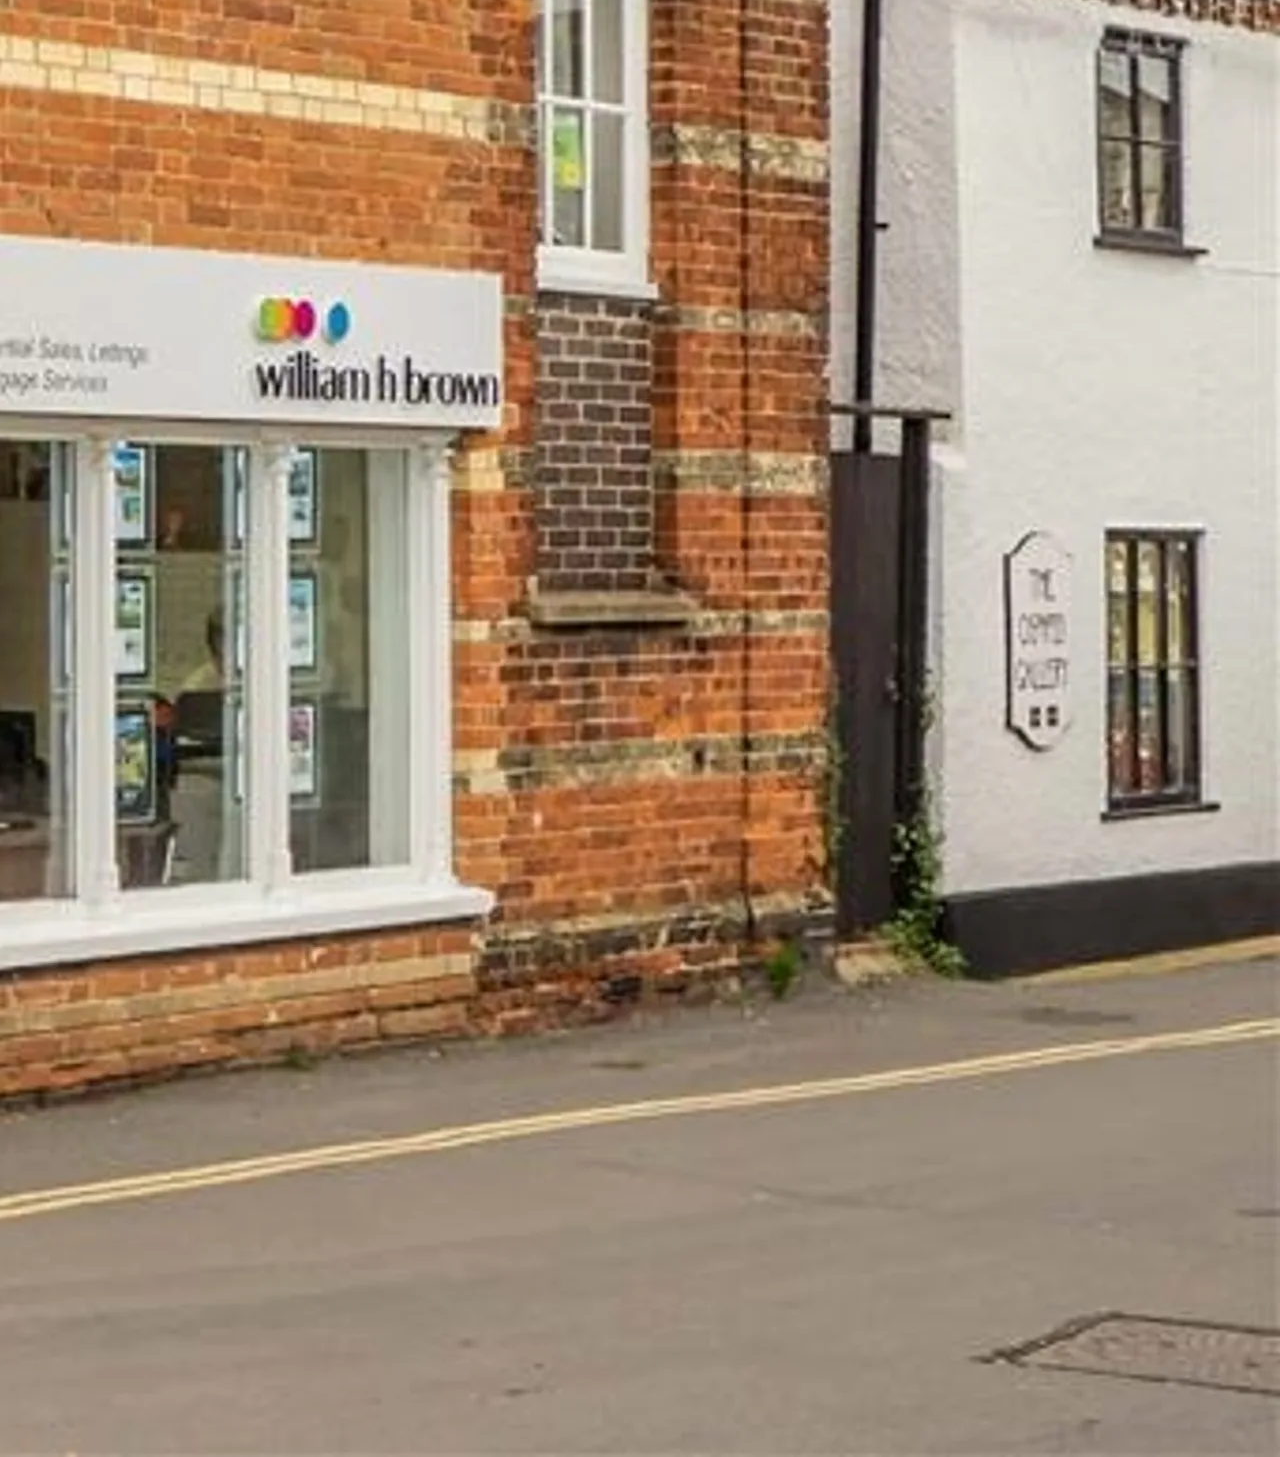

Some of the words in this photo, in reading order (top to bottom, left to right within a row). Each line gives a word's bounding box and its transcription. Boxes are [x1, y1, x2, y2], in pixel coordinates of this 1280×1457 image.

[82, 341, 150, 370] Lettings
[42, 369, 108, 395] Services
[255, 350, 370, 403] william
[377, 356, 396, 403] h
[404, 357, 499, 407] brown
